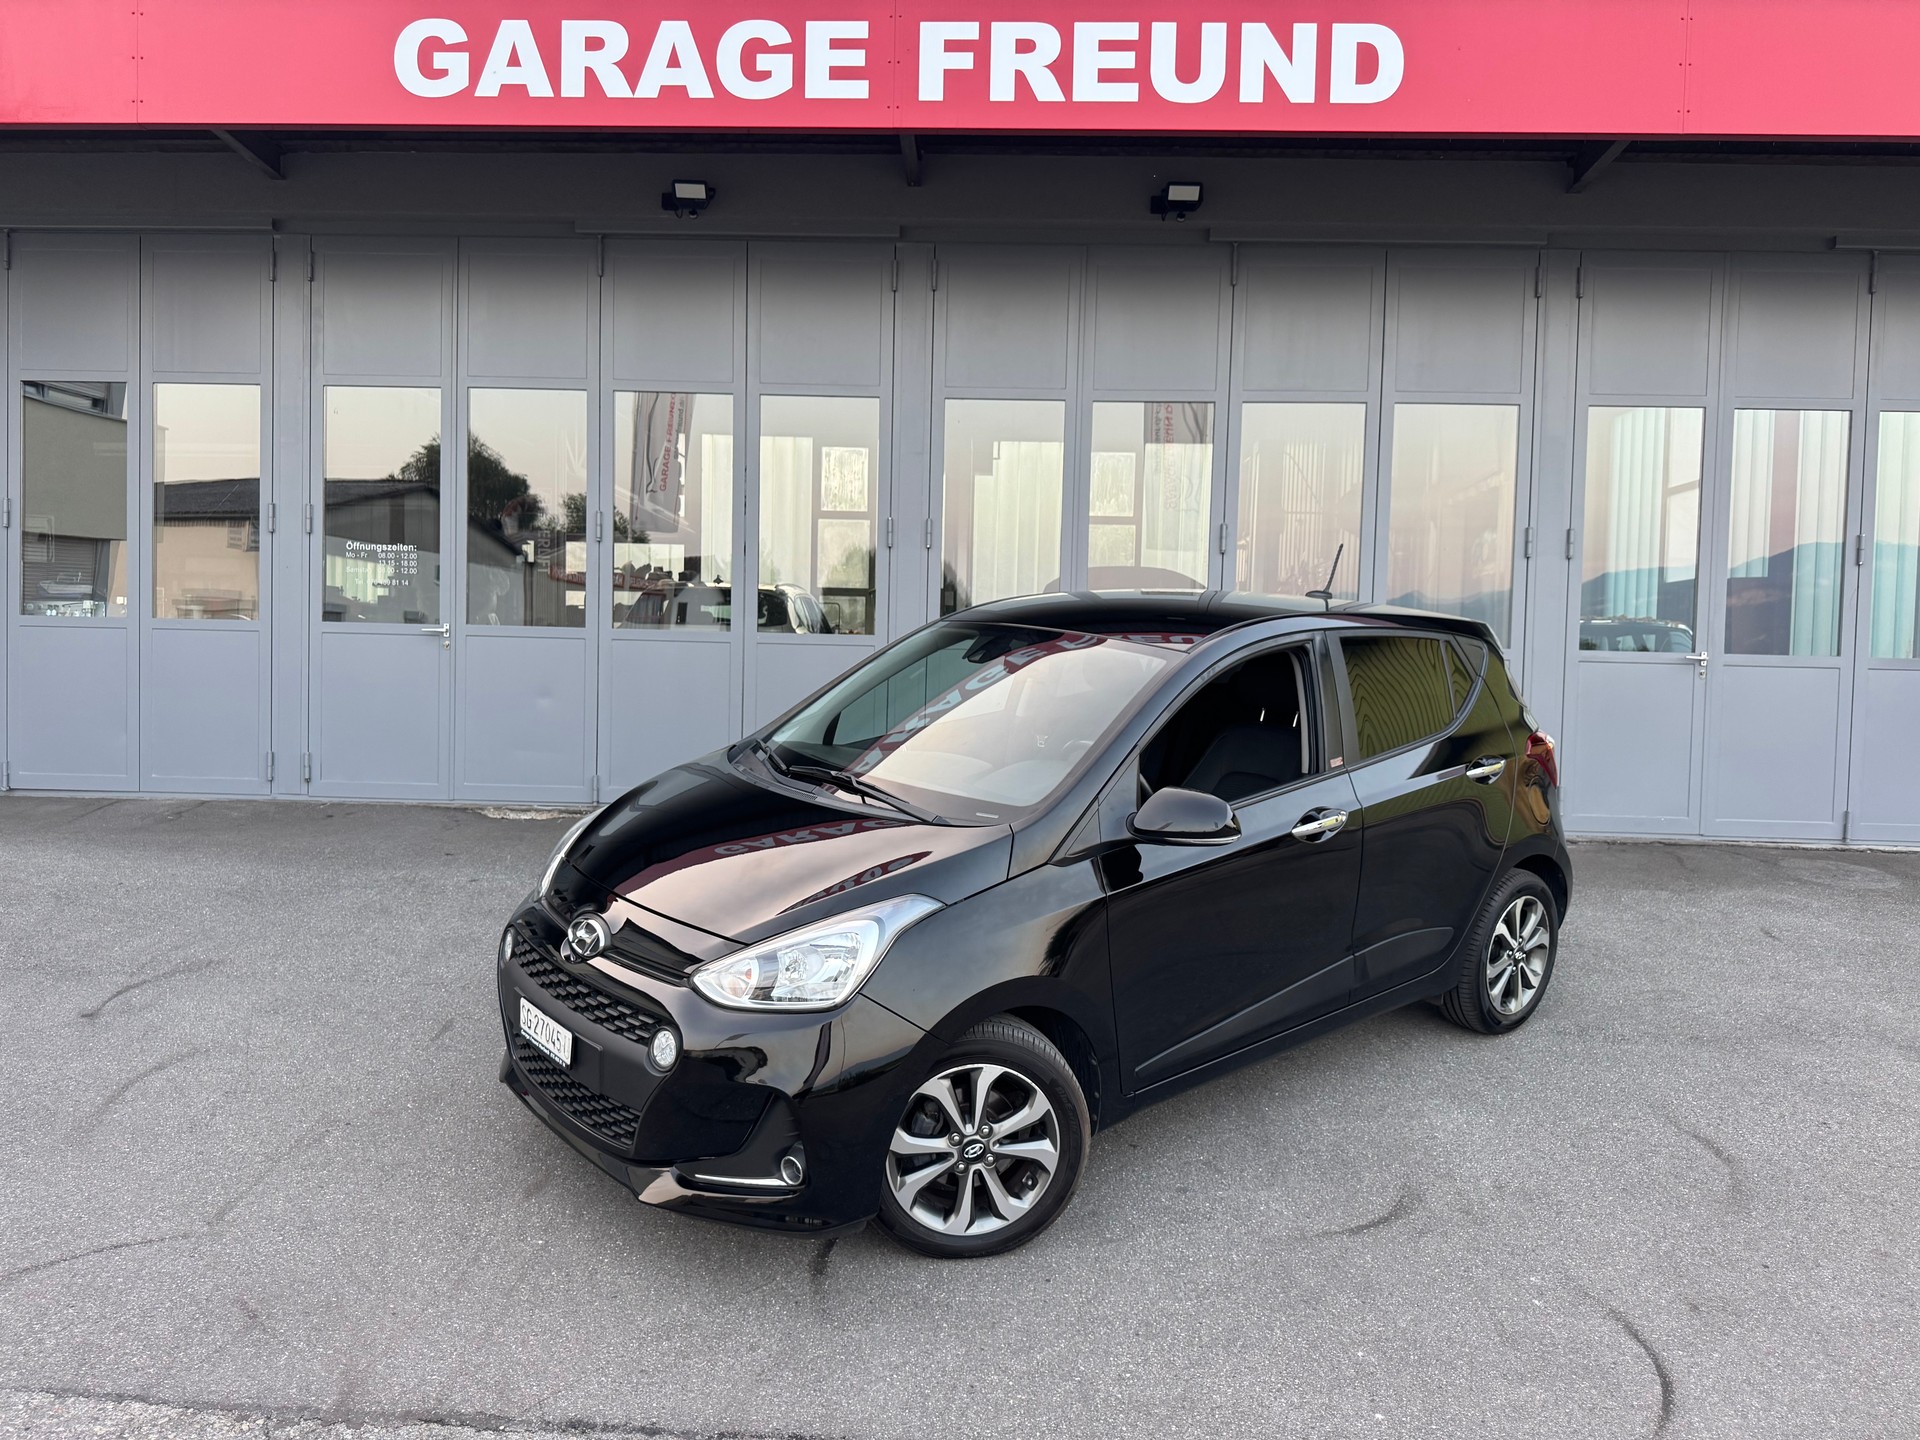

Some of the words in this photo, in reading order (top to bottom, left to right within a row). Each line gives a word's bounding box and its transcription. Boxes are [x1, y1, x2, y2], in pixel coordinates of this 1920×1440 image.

[393, 18, 870, 101] GARAGE
[918, 21, 1405, 105] FREUND
[660, 446, 672, 491] GARAGE
[346, 541, 417, 552] Öffnungszeiten:
[521, 1005, 533, 1027] SG
[533, 1014, 562, 1053] 27045
